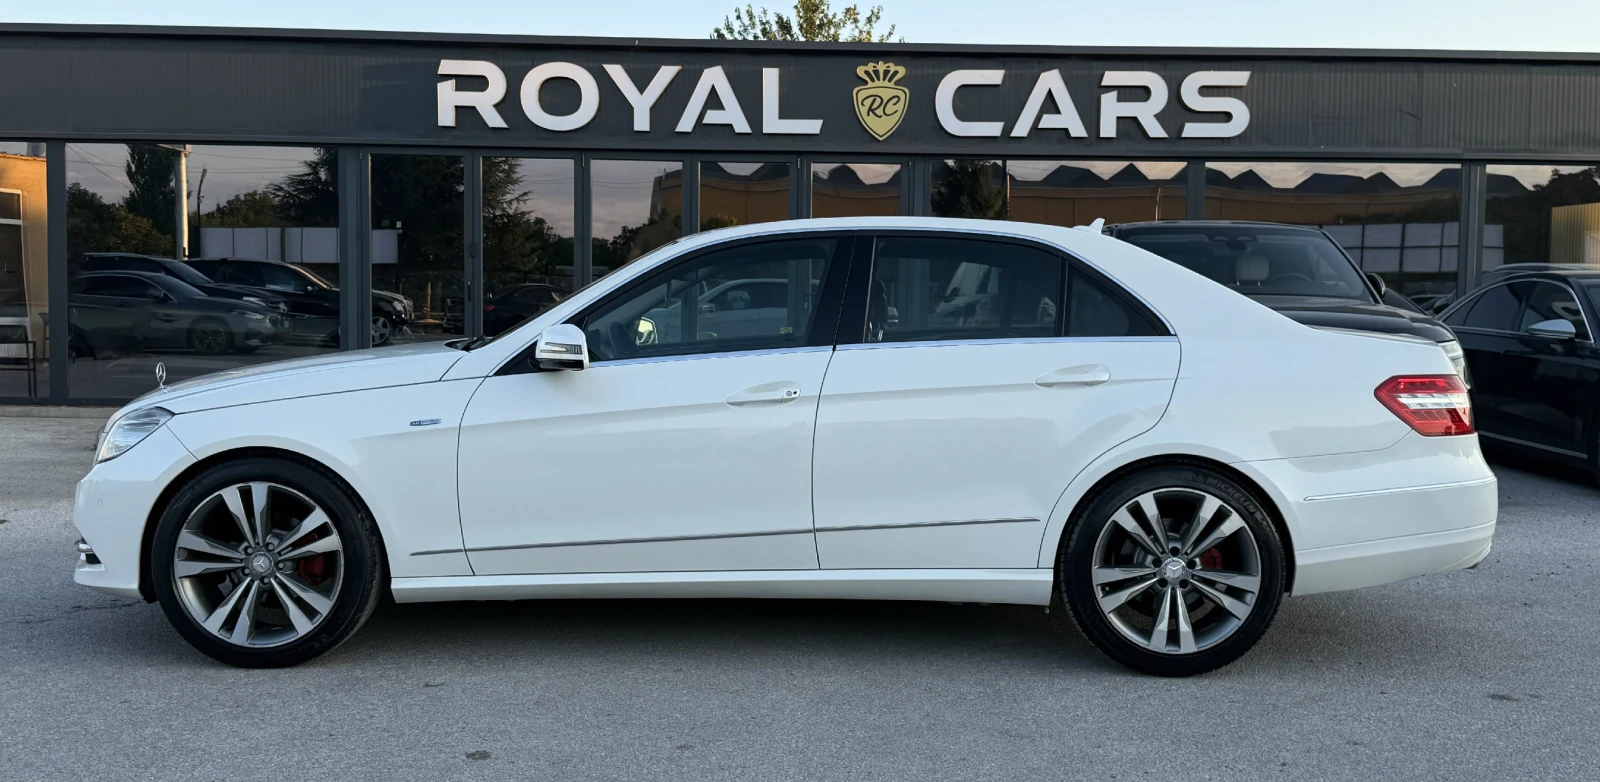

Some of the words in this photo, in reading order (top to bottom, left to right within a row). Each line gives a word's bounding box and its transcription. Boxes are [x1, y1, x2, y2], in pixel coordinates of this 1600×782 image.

[437, 59, 823, 134] ROYAL
[935, 68, 1252, 138] CARS
[861, 94, 901, 118] RC
[1205, 478, 1257, 514] MICHELIN
